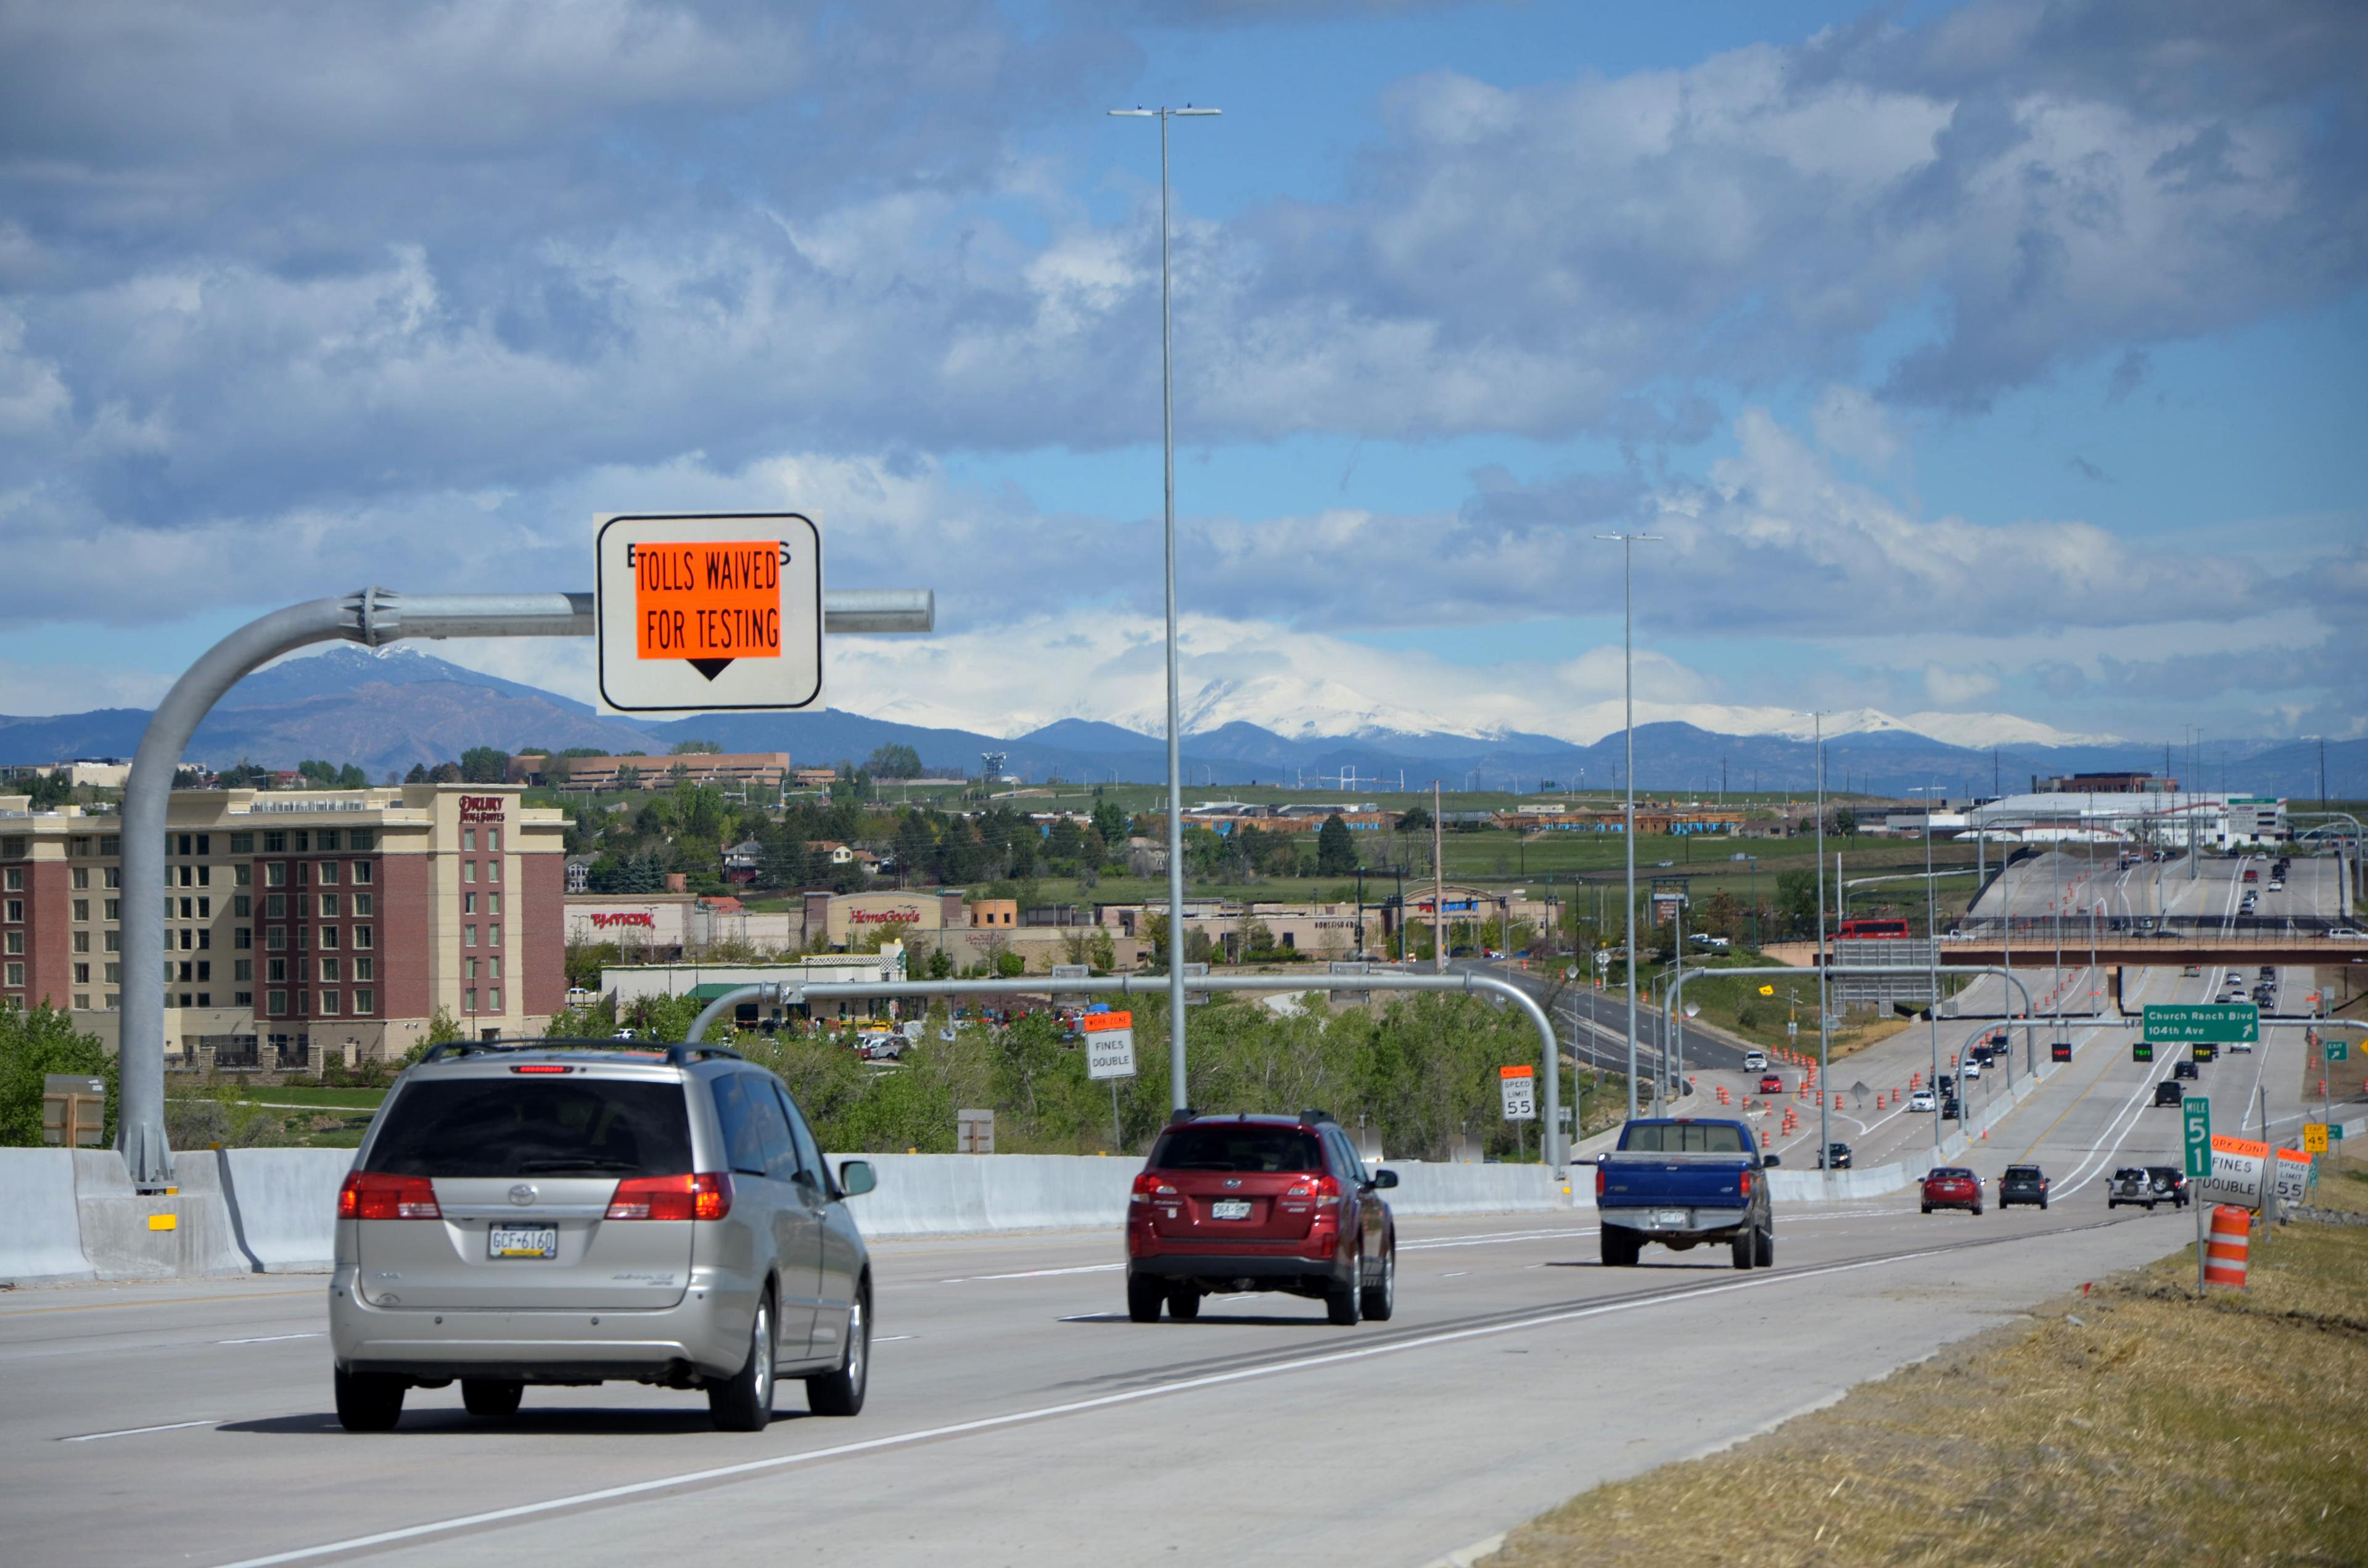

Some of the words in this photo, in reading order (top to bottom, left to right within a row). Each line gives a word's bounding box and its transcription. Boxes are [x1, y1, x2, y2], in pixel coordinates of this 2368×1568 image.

[638, 551, 694, 591] TOLLS
[705, 551, 776, 589] WAIVED
[648, 609, 684, 649] FOR
[696, 608, 778, 648] TESTING
[1089, 1018, 1106, 1026] WORK
[1110, 1016, 1128, 1025] ZONE
[2148, 1011, 2187, 1020] Church
[2192, 1012, 2224, 1020] Ranch
[2229, 1012, 2253, 1020] Blvd
[2149, 1026, 2179, 1035] 104th
[1096, 1041, 1124, 1051] FINES
[1093, 1056, 1130, 1067] DOUBLE
[1508, 1101, 1531, 1114] 55
[2187, 1102, 2206, 1112] MILE
[2212, 1138, 2232, 1149] ORK
[2238, 1144, 2267, 1154] ZONE
[2213, 1157, 2252, 1173] FINES
[2279, 1161, 2307, 1172] SPEED
[2280, 1172, 2302, 1180] LIMIT
[2203, 1177, 2255, 1196] DOUBLE
[2277, 1181, 2302, 1197] 55
